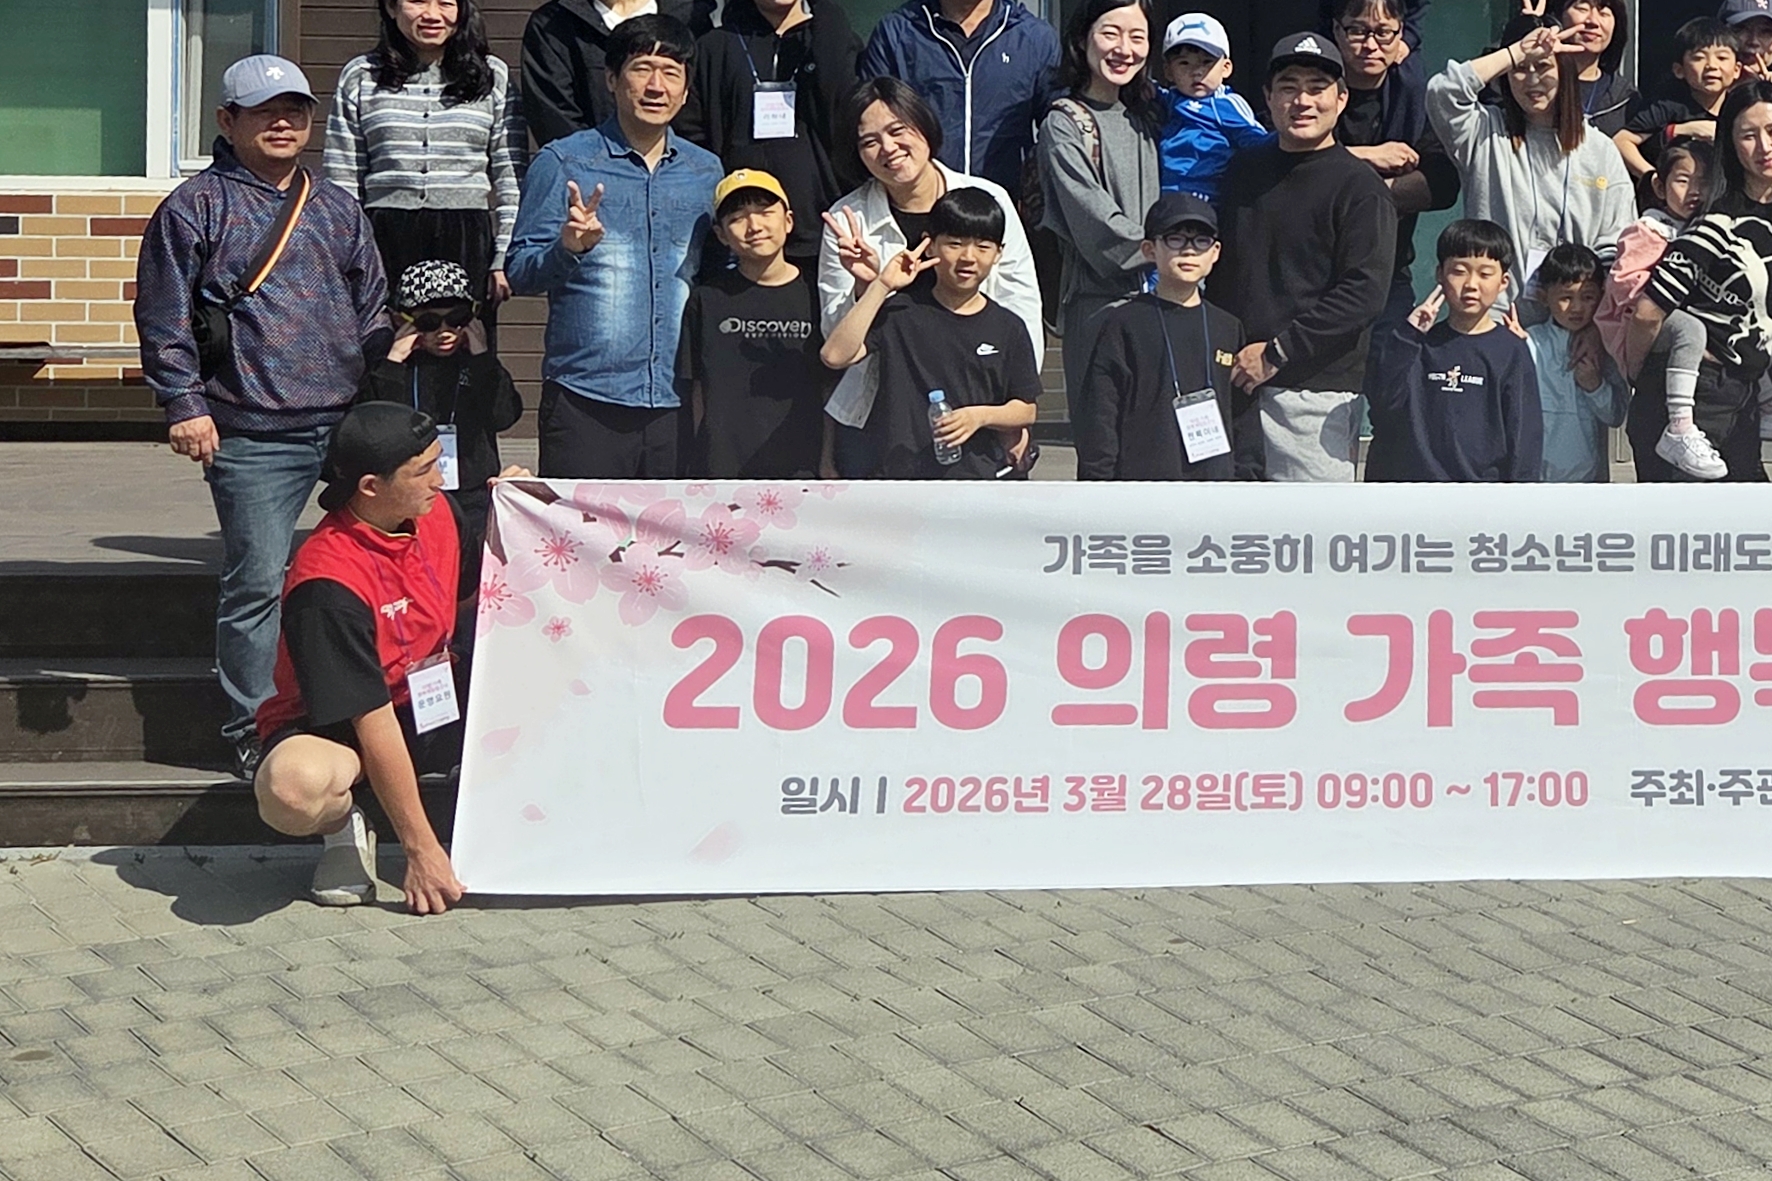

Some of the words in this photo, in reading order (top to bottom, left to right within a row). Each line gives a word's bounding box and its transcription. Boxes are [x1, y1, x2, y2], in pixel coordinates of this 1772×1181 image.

[1043, 534, 1172, 575] 가족을
[1186, 533, 1313, 574] 소중히
[1329, 533, 1455, 574] 여기는
[1468, 532, 1636, 573] 청소년은
[1650, 532, 1772, 573] 미래도
[663, 615, 1006, 730] 2026
[1052, 612, 1296, 729] 의령
[1345, 611, 1583, 727] 가족
[780, 776, 860, 815] 일시
[903, 776, 1049, 812] 2026년
[1064, 775, 1126, 811] 3월
[1141, 772, 1303, 811] 28일(토)
[1317, 774, 1433, 809] 09:00
[1485, 772, 1587, 806] 17:00
